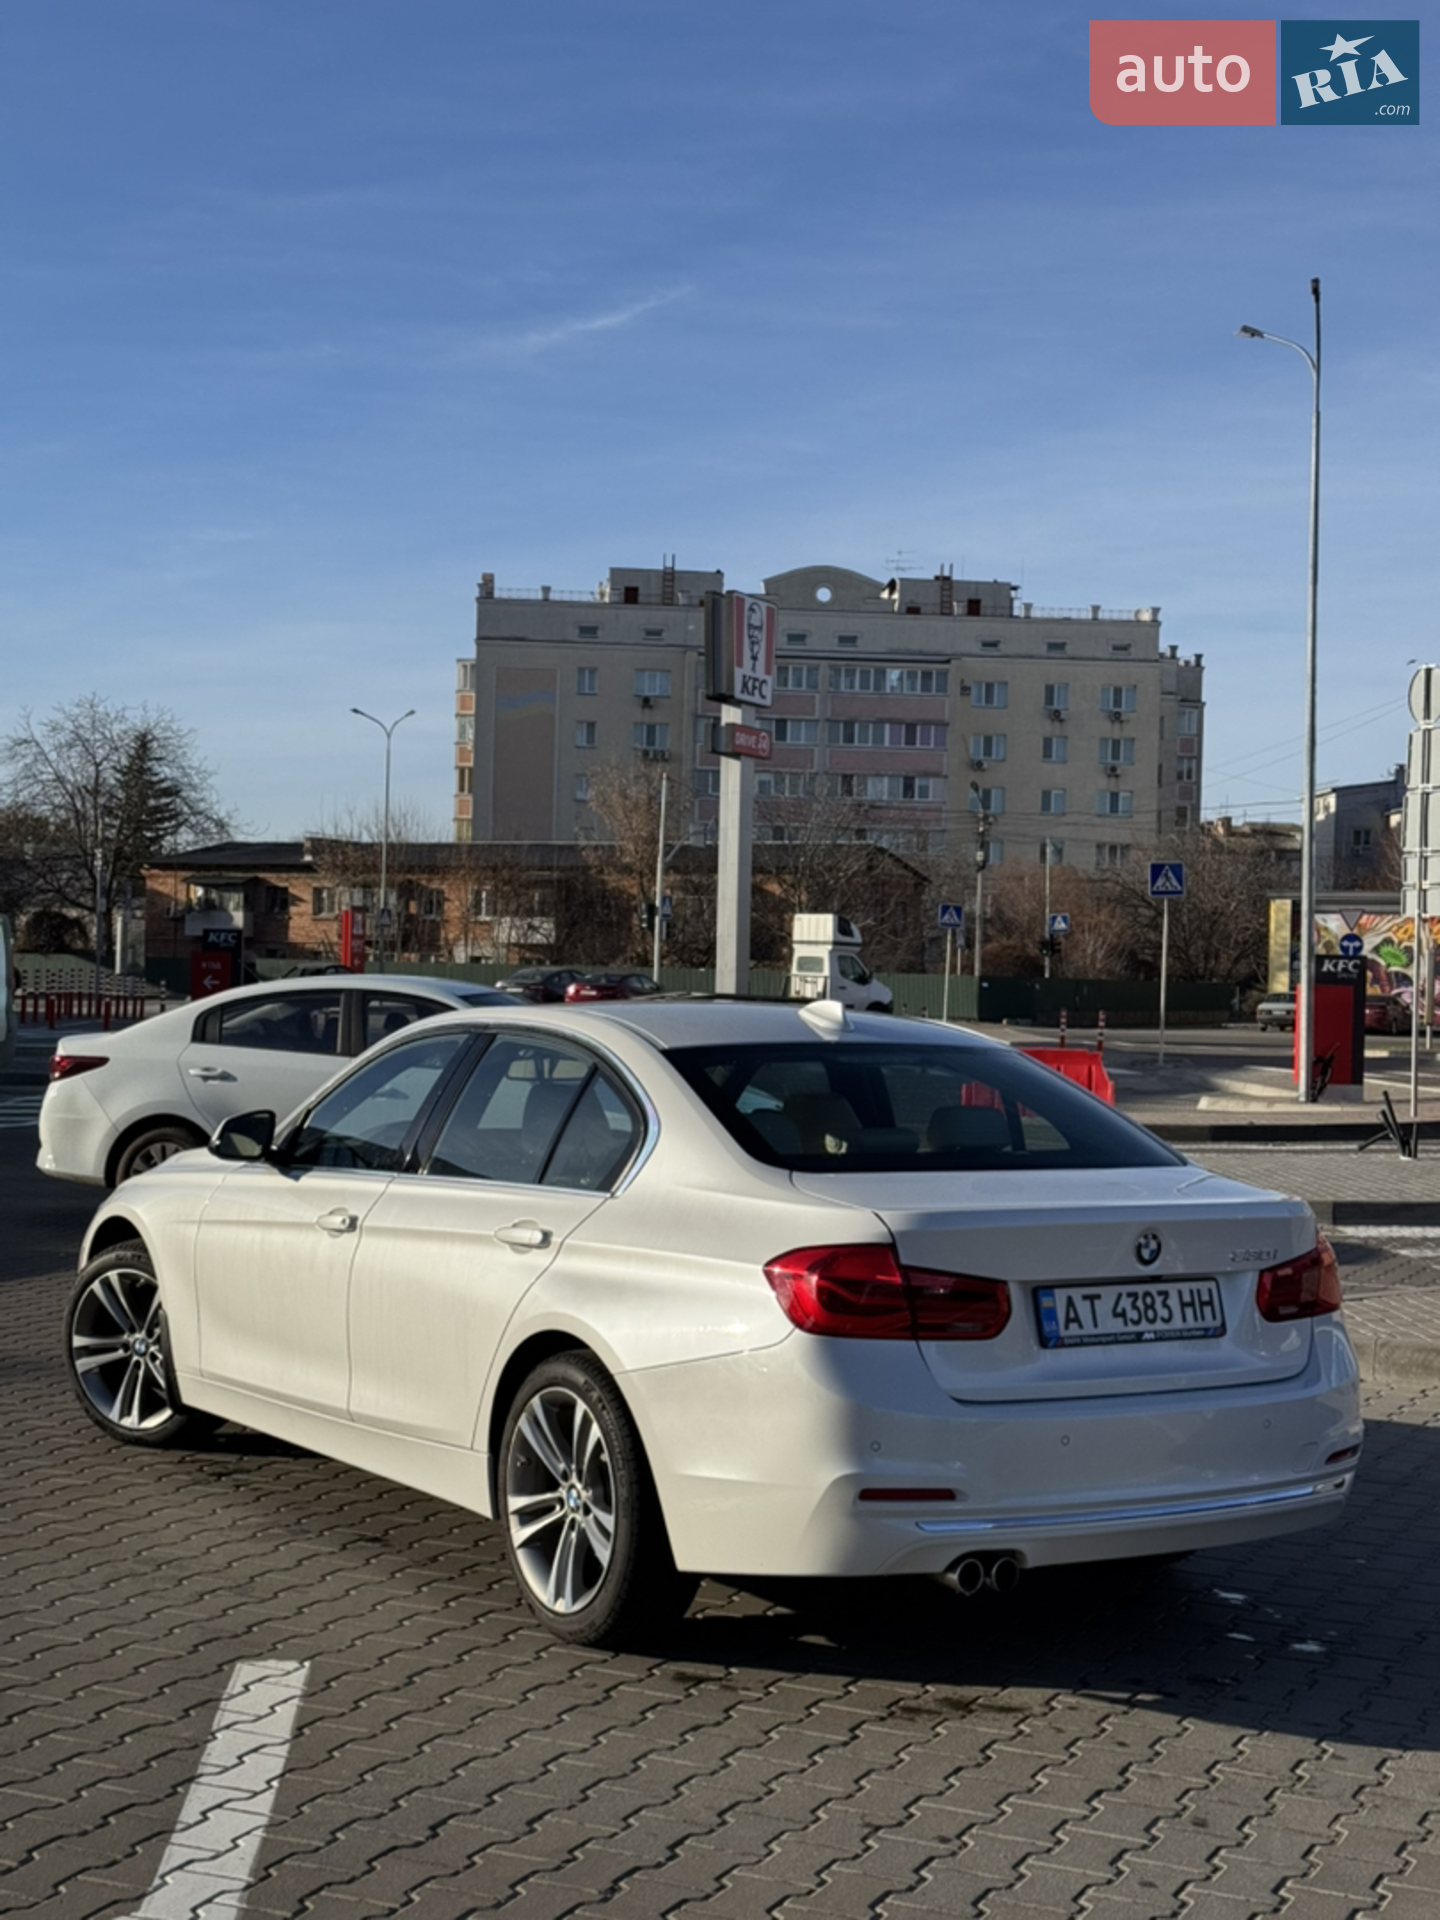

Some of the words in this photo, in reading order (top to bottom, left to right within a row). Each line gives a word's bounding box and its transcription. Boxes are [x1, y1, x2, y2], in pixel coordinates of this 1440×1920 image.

[741, 674, 768, 699] KFC
[735, 732, 757, 749] DRIVE
[207, 931, 238, 944] KFC
[1321, 958, 1361, 974] KFC
[1064, 1294, 1102, 1330] AT
[1112, 1290, 1173, 1327] 4383
[1178, 1287, 1217, 1323] HH
